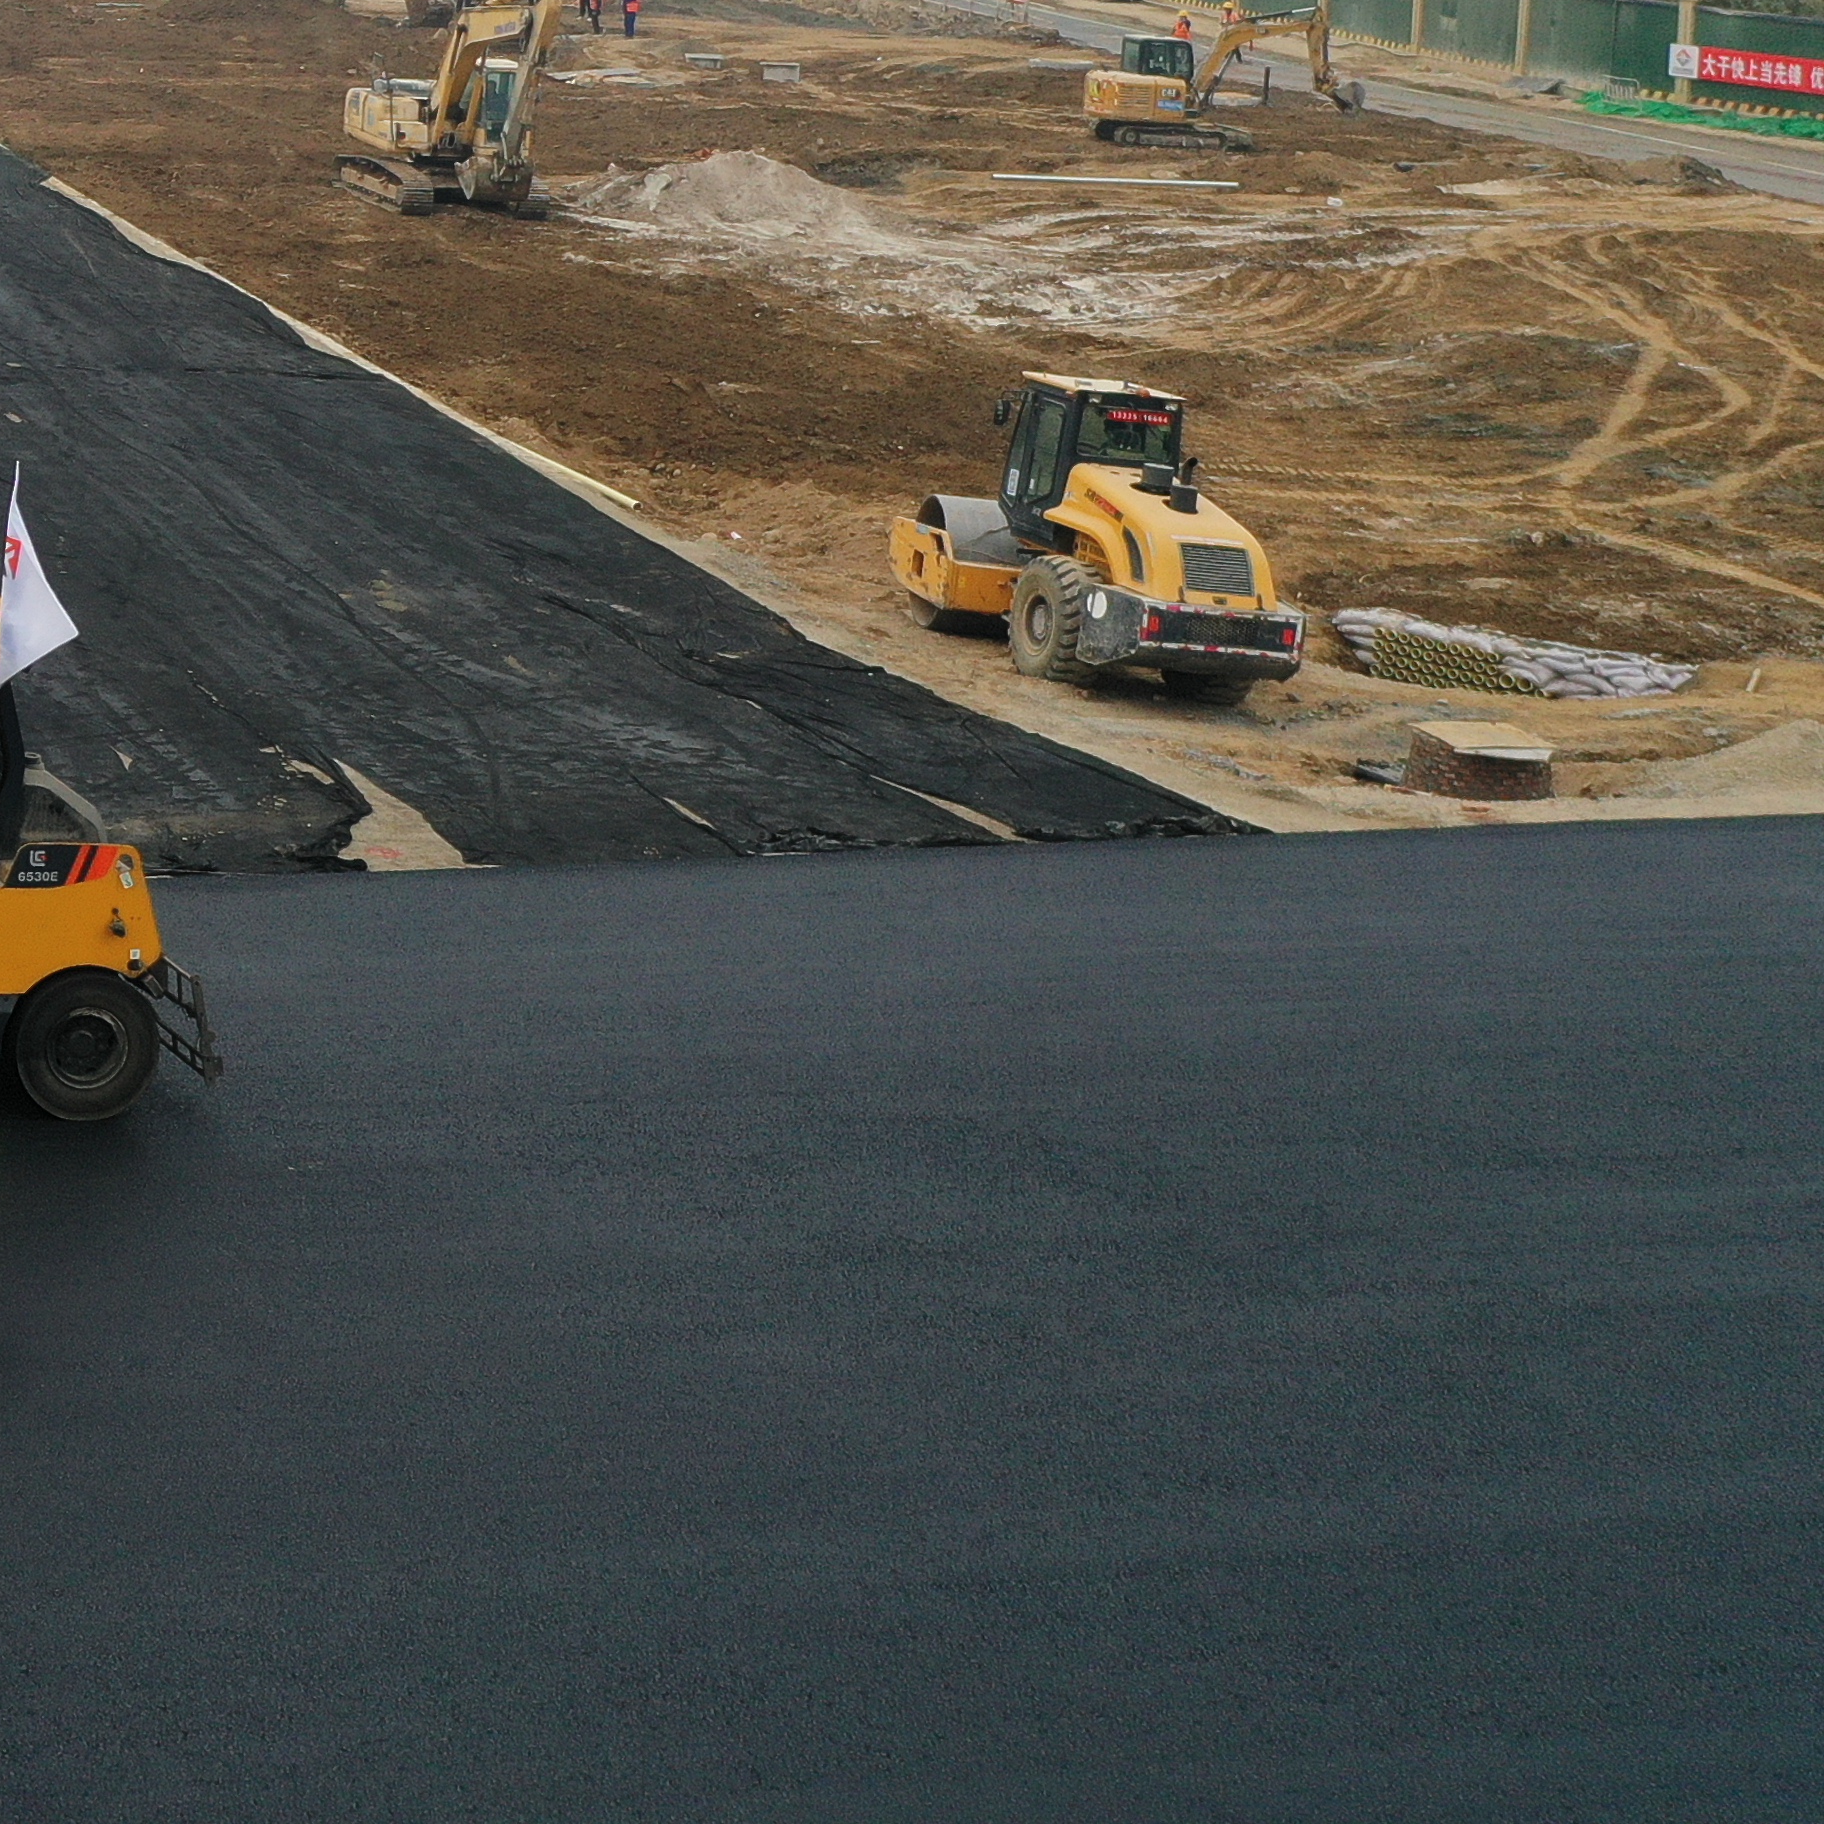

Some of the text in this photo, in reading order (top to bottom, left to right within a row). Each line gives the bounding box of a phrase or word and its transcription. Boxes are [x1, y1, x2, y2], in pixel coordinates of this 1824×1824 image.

[1703, 53, 1801, 86] 大干快上当先锋
[17, 871, 58, 882] 6530E
